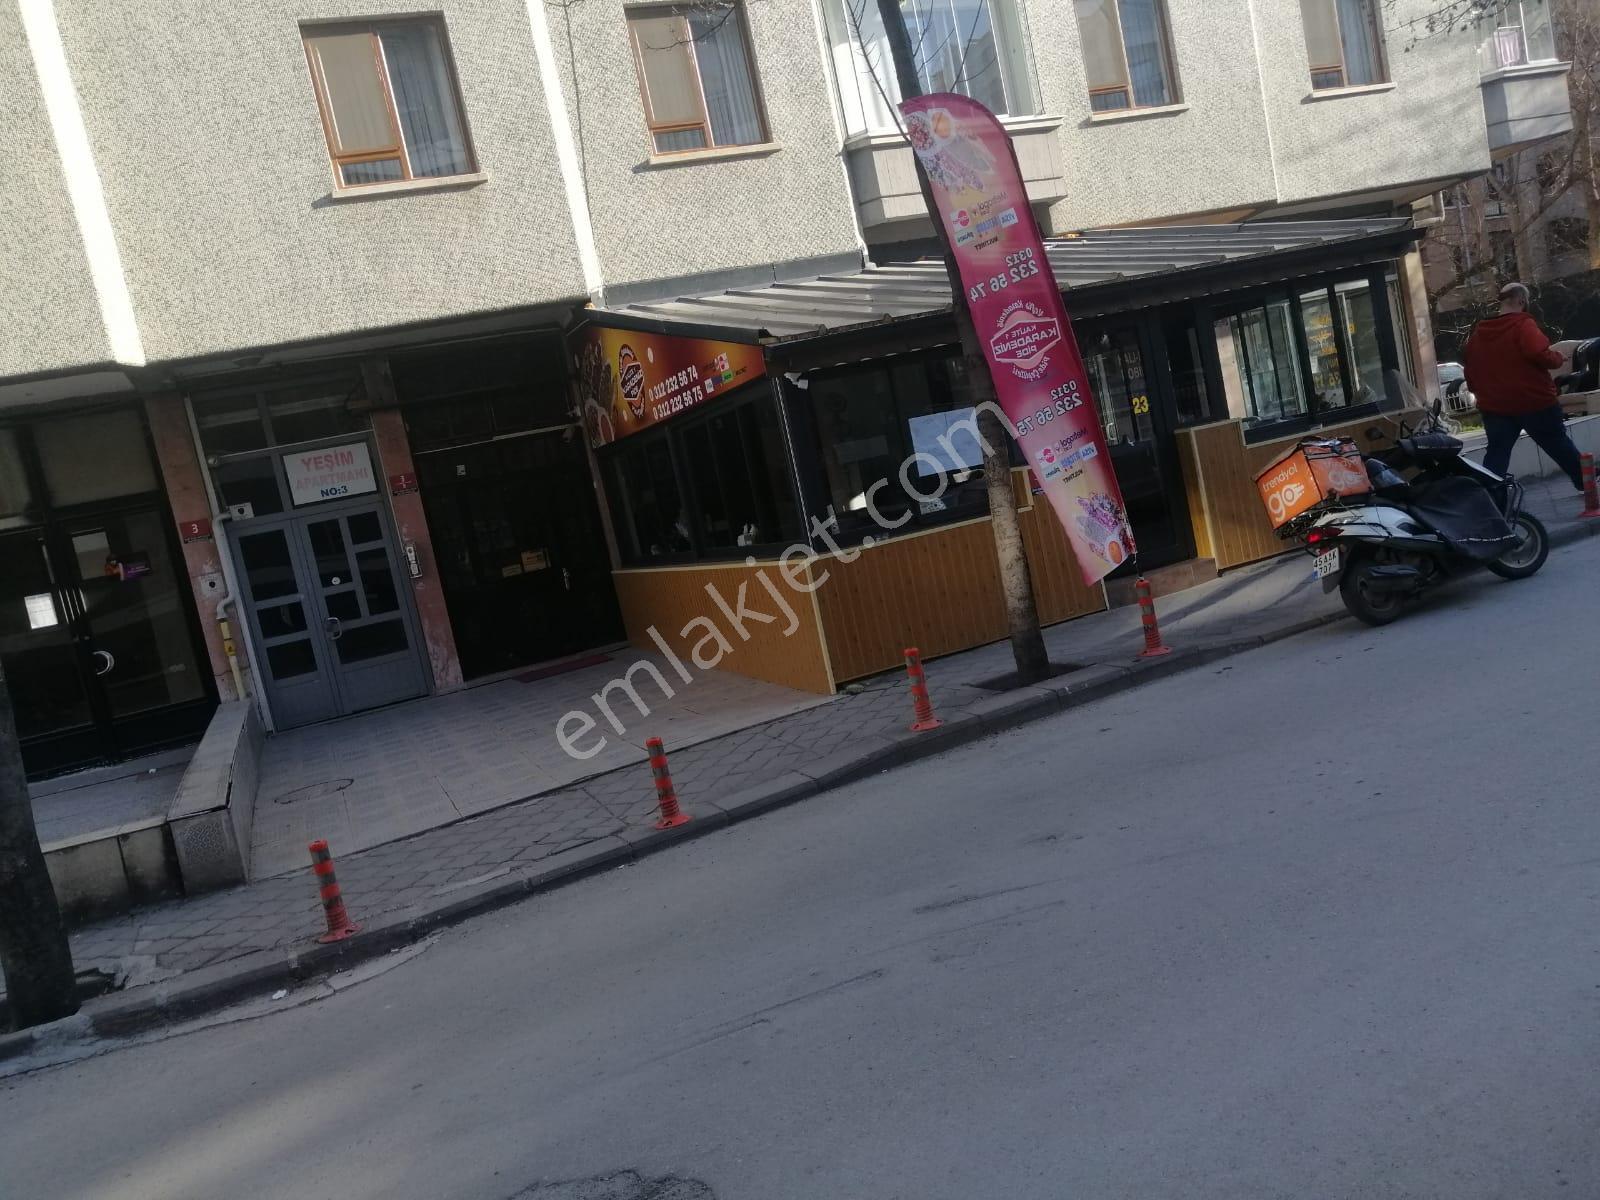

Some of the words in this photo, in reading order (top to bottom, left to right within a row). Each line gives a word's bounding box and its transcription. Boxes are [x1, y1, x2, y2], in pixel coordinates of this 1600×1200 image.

[648, 388, 654, 402] 0
[654, 382, 666, 400] 312
[665, 375, 679, 394] 232
[678, 370, 689, 387] 56
[687, 364, 699, 380] 74
[652, 406, 659, 420] 0
[658, 400, 671, 418] 312
[670, 394, 684, 413] 232
[682, 389, 694, 407] 56
[691, 385, 703, 402] 75
[1132, 395, 1150, 415] 23
[301, 450, 354, 472] YEŞİM
[295, 467, 369, 491] APARTMANI
[1262, 463, 1299, 493] trendyol
[320, 485, 349, 498] NO:3
[1268, 484, 1300, 523] go
[191, 523, 199, 534] 3
[1313, 557, 1323, 569] 45
[1318, 563, 1333, 577] 707
